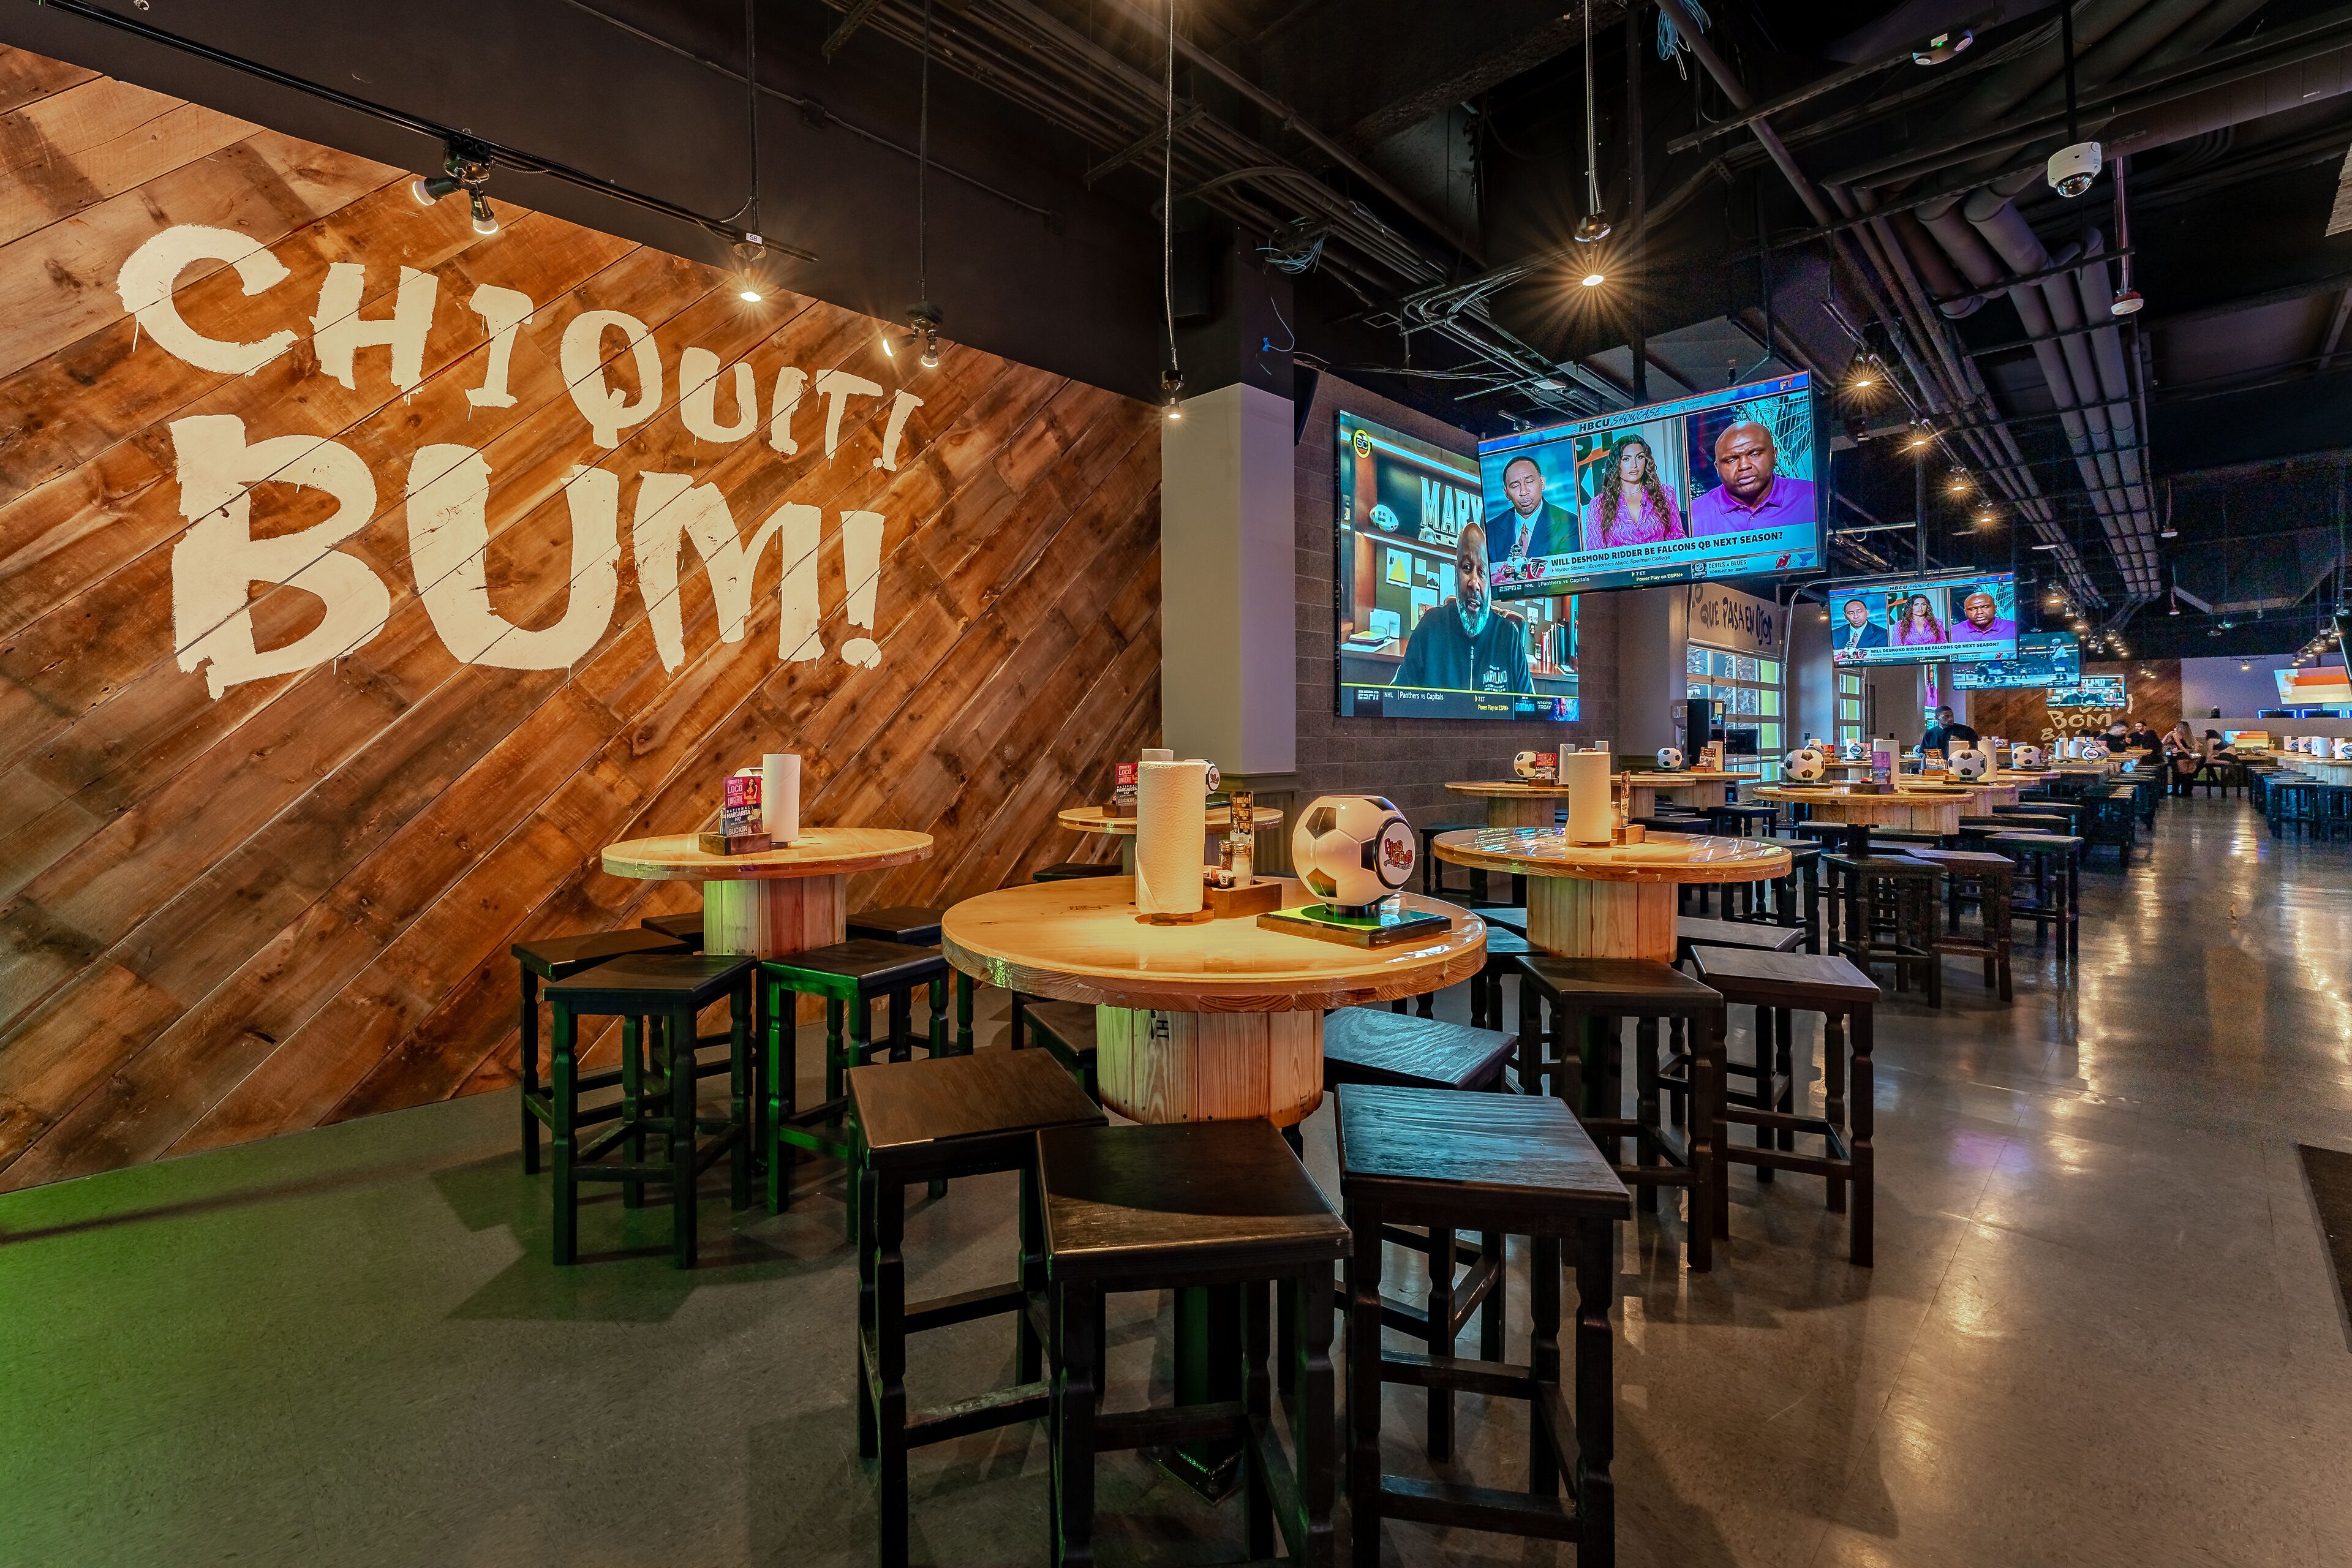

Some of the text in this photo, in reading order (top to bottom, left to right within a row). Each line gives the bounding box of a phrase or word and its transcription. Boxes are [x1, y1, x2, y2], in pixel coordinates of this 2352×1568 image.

[1779, 378, 1795, 391] FT
[1578, 406, 1661, 433] HBCU SHOWCASE
[1355, 437, 1368, 450] SC
[1551, 530, 1784, 567] WILL DESMOND RIDDER BE FALCONS QB NEXT SEASON?
[169, 413, 886, 701] BUM!
[1589, 560, 1613, 569] Economics
[1614, 559, 1629, 567] Major,
[1630, 555, 1650, 565] Spelman
[1569, 575, 1590, 584] Capitals
[1700, 601, 1719, 630] QUE
[1722, 597, 1744, 631] PASA
[1483, 670, 1507, 684] MARYLAND
[1358, 689, 1379, 701] ESPN
[1427, 693, 1444, 701] Capitals
[2047, 710, 2112, 729] BOM
[728, 785, 743, 794] LOCO
[728, 796, 743, 805] LINGERIE
[727, 810, 751, 819] MARGARITA
